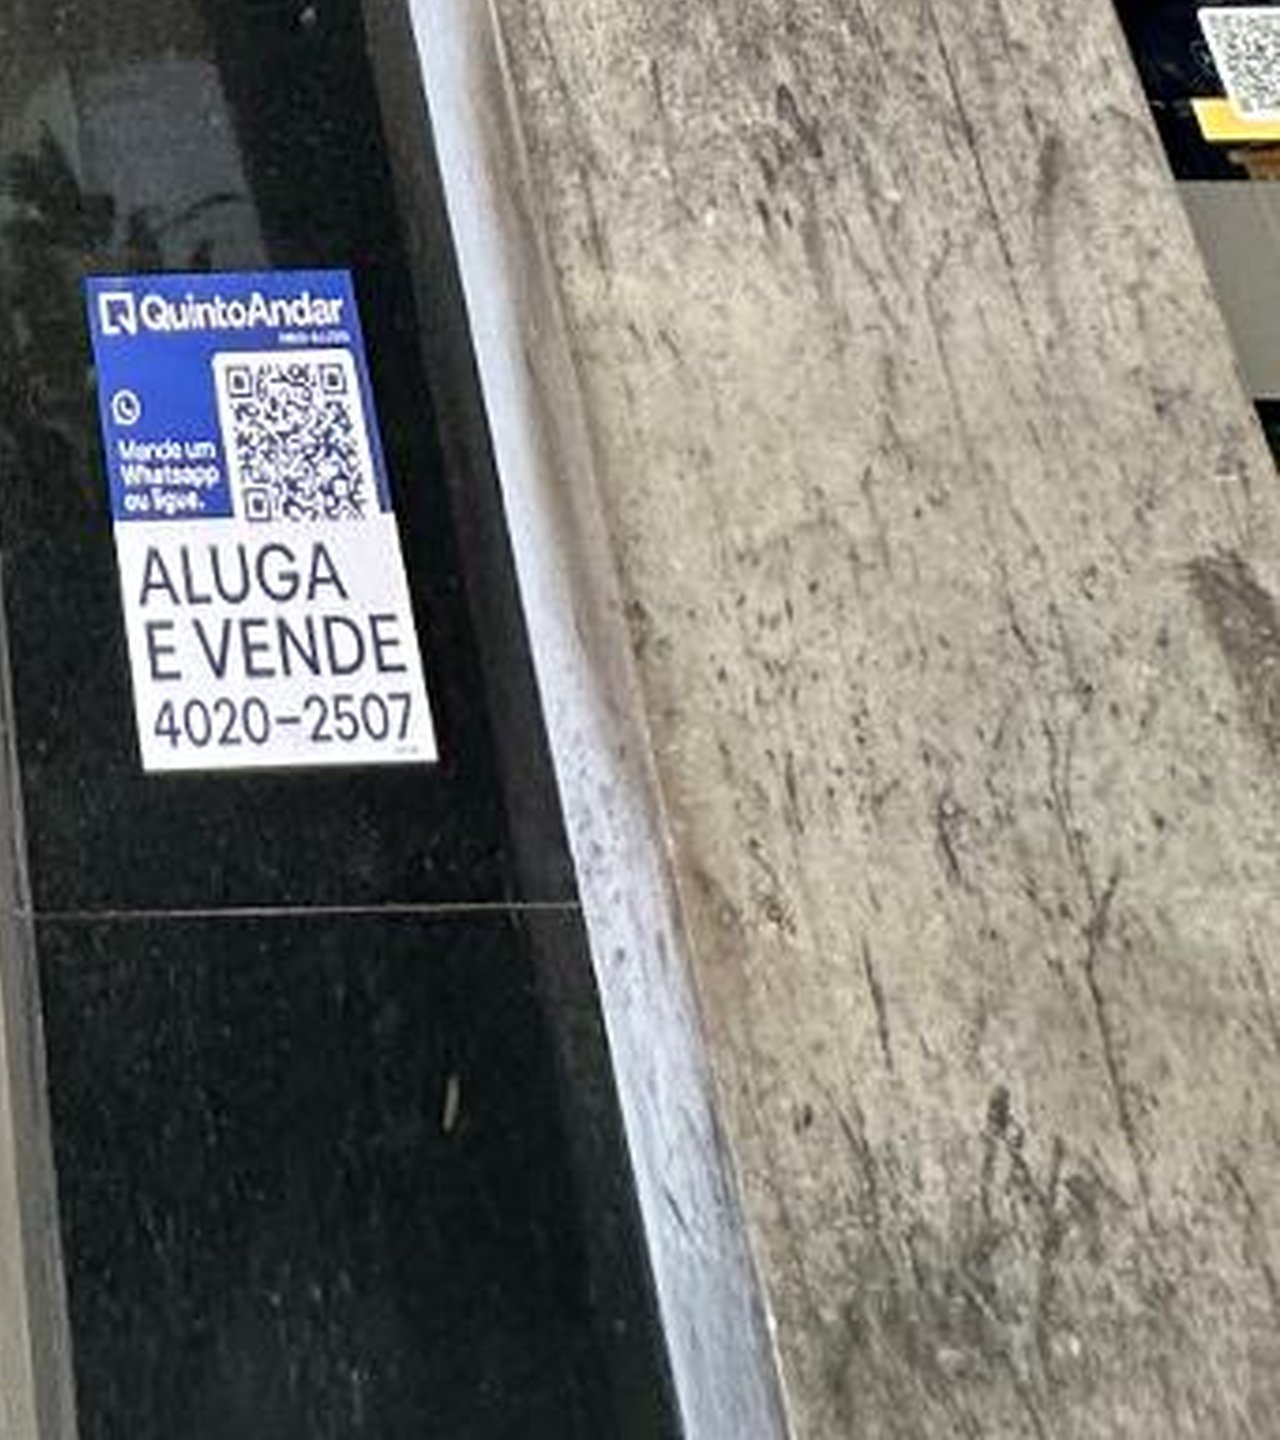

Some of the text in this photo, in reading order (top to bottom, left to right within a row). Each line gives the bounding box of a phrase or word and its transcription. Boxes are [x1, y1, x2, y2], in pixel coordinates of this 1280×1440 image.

[141, 291, 344, 331] QuintoAndar
[139, 541, 349, 607] ALUGA
[144, 612, 408, 682] E VENDE
[153, 691, 414, 749] 4020-2507
